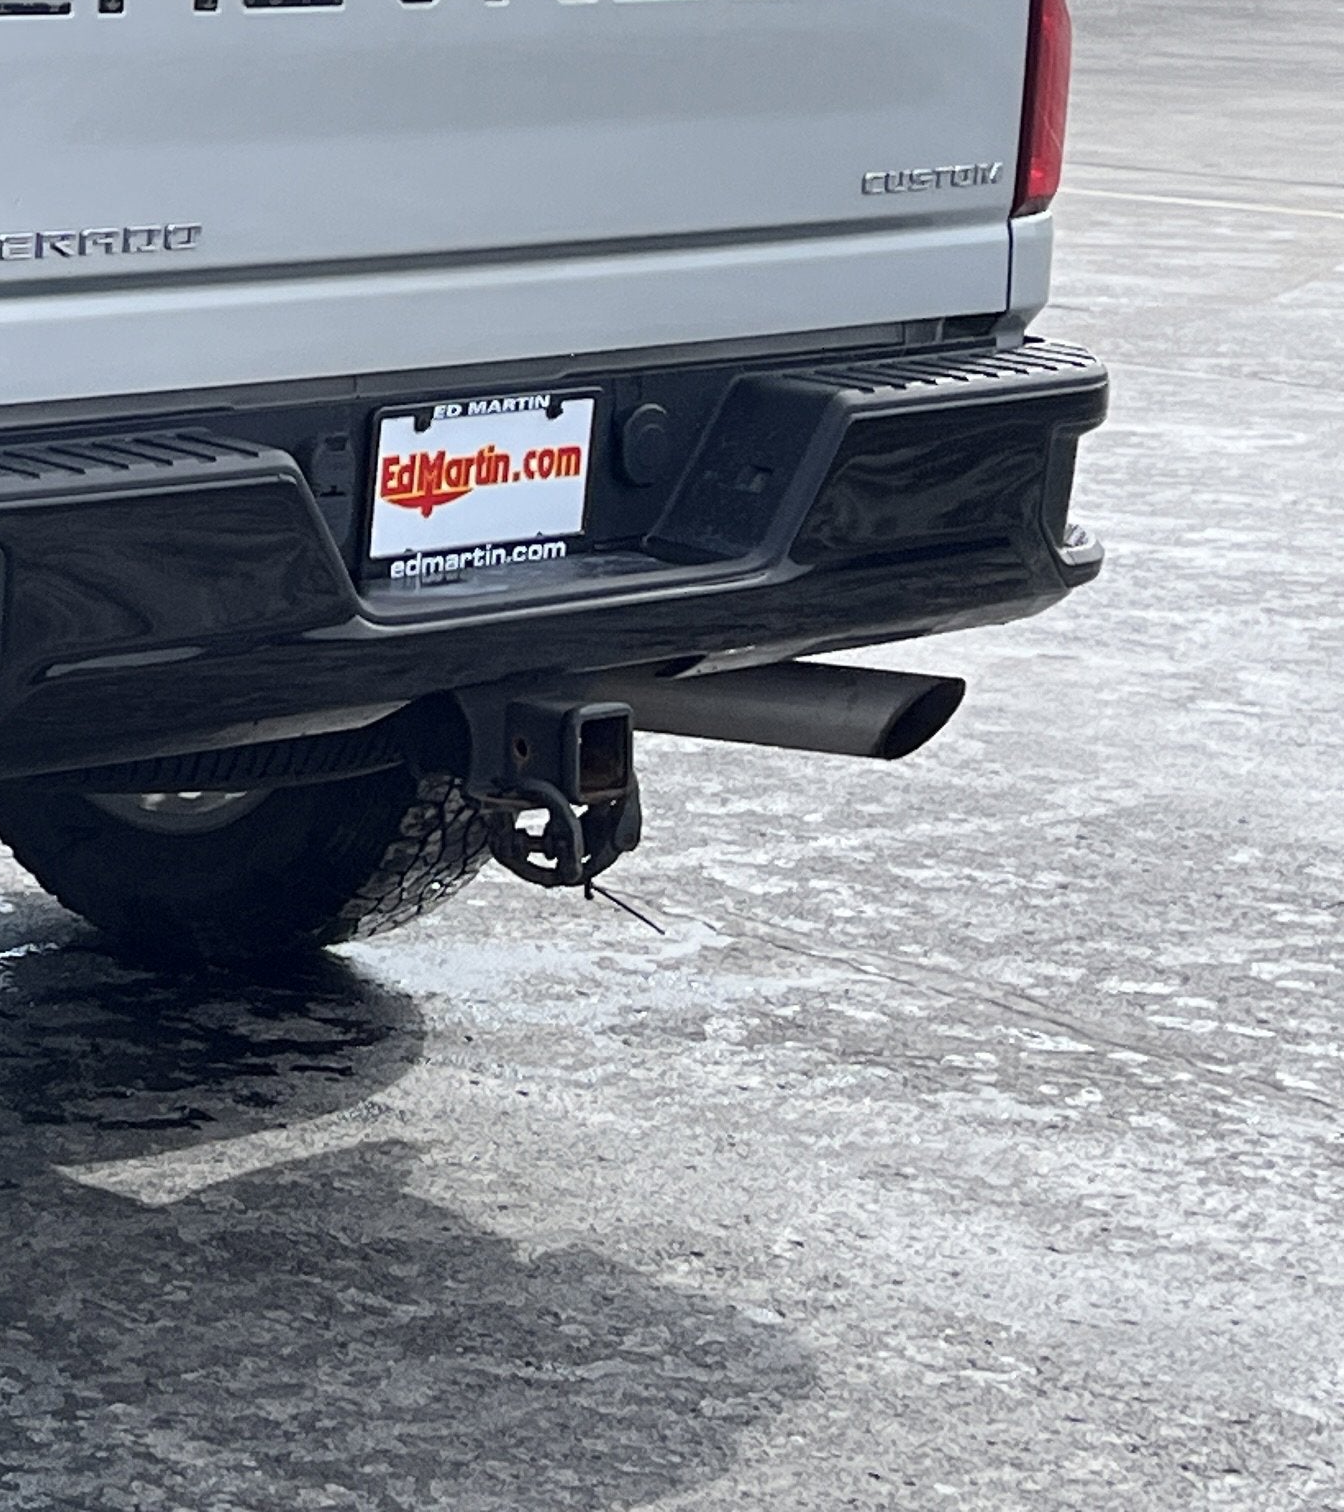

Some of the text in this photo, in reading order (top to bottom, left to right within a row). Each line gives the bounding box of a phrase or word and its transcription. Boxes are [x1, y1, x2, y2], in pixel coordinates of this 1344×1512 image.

[861, 162, 1003, 195] CUSTOM
[432, 395, 551, 420] ED MARTIN
[390, 540, 567, 579] edmartin.com
